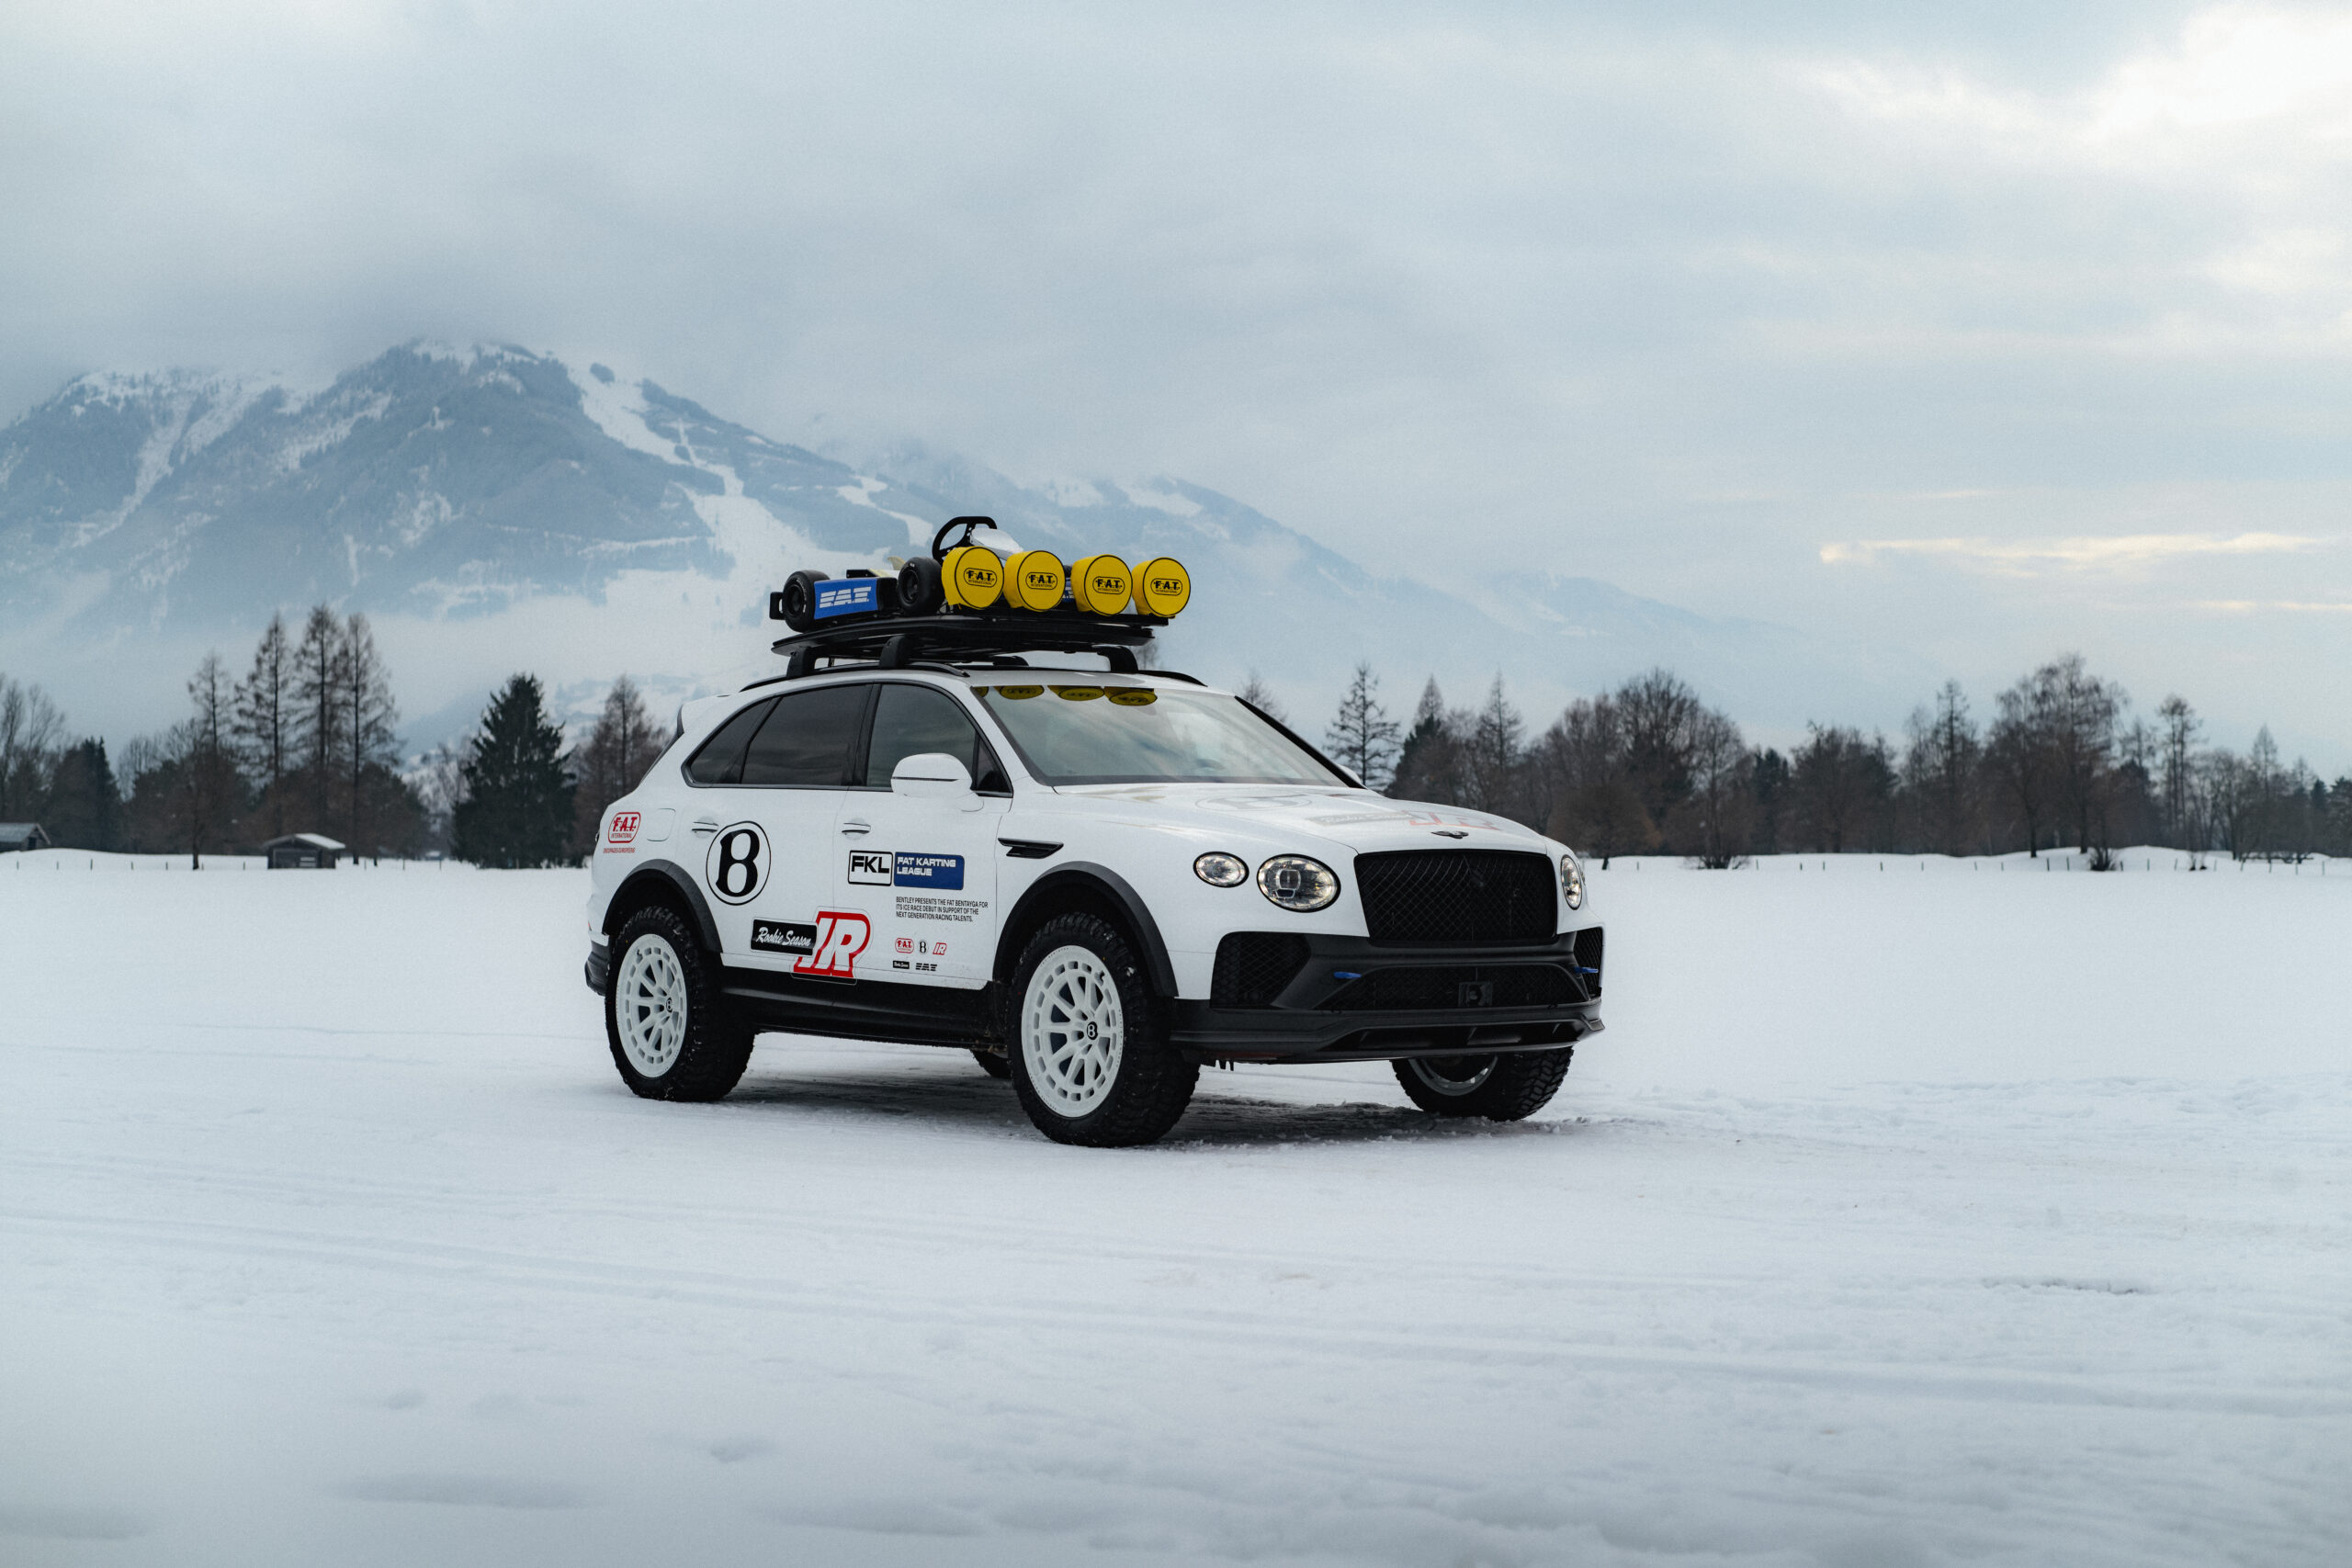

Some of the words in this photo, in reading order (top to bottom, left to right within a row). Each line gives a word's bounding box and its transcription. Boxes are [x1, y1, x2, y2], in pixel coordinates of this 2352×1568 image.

[851, 855, 890, 874] FKL
[897, 856, 915, 865] FAT
[916, 857, 956, 868] KARTING
[897, 866, 933, 876] LEAGUE
[896, 896, 914, 904] BENTLEY
[755, 926, 784, 944] Rookie
[782, 930, 812, 947] Season
